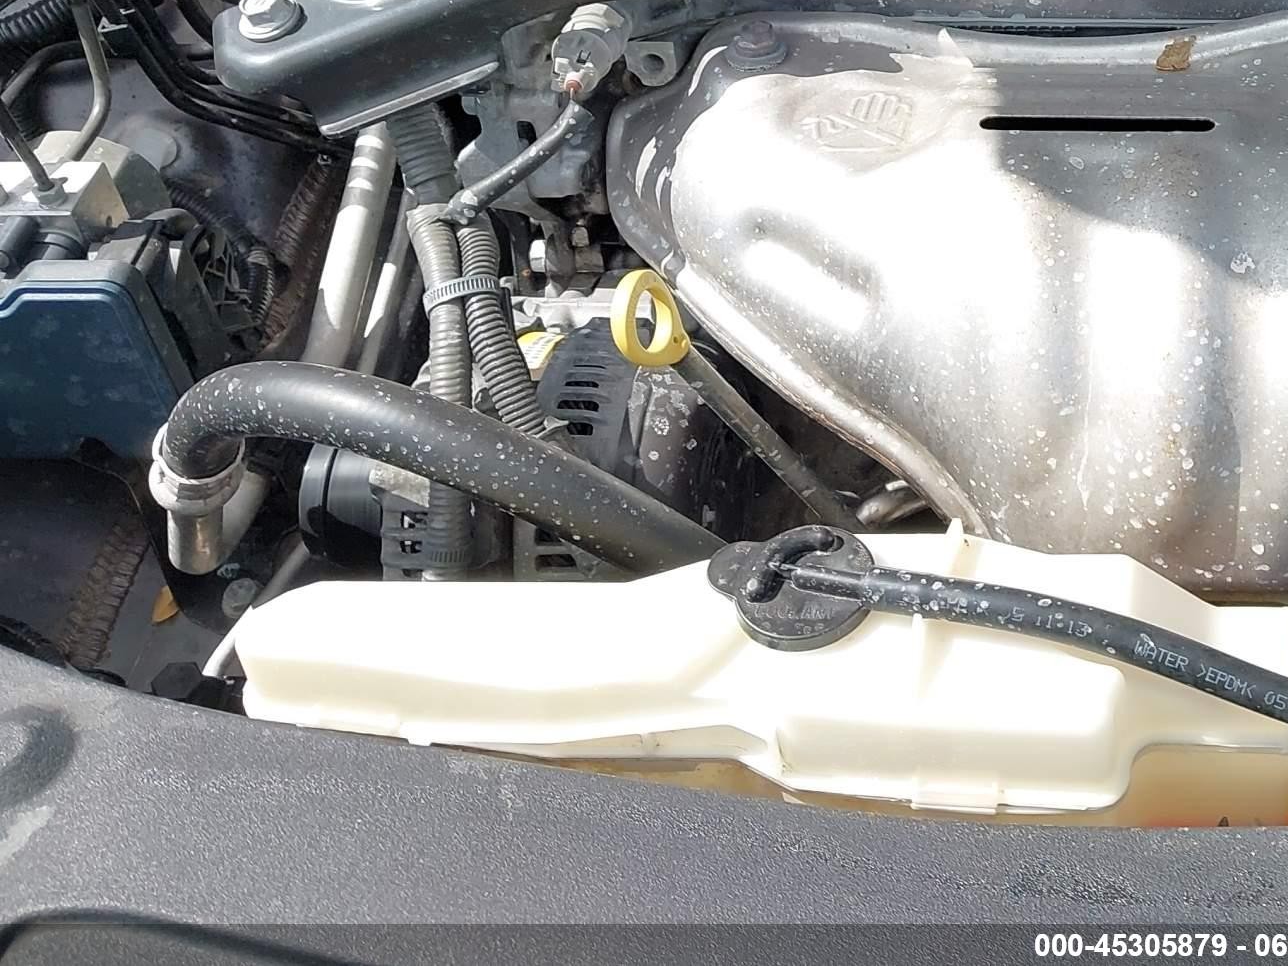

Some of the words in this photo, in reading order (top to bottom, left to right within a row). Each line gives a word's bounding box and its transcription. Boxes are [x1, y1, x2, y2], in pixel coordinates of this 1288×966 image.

[1134, 638, 1190, 669] WATER
[1195, 663, 1257, 700] >EPDM<
[1263, 690, 1288, 712] 05
